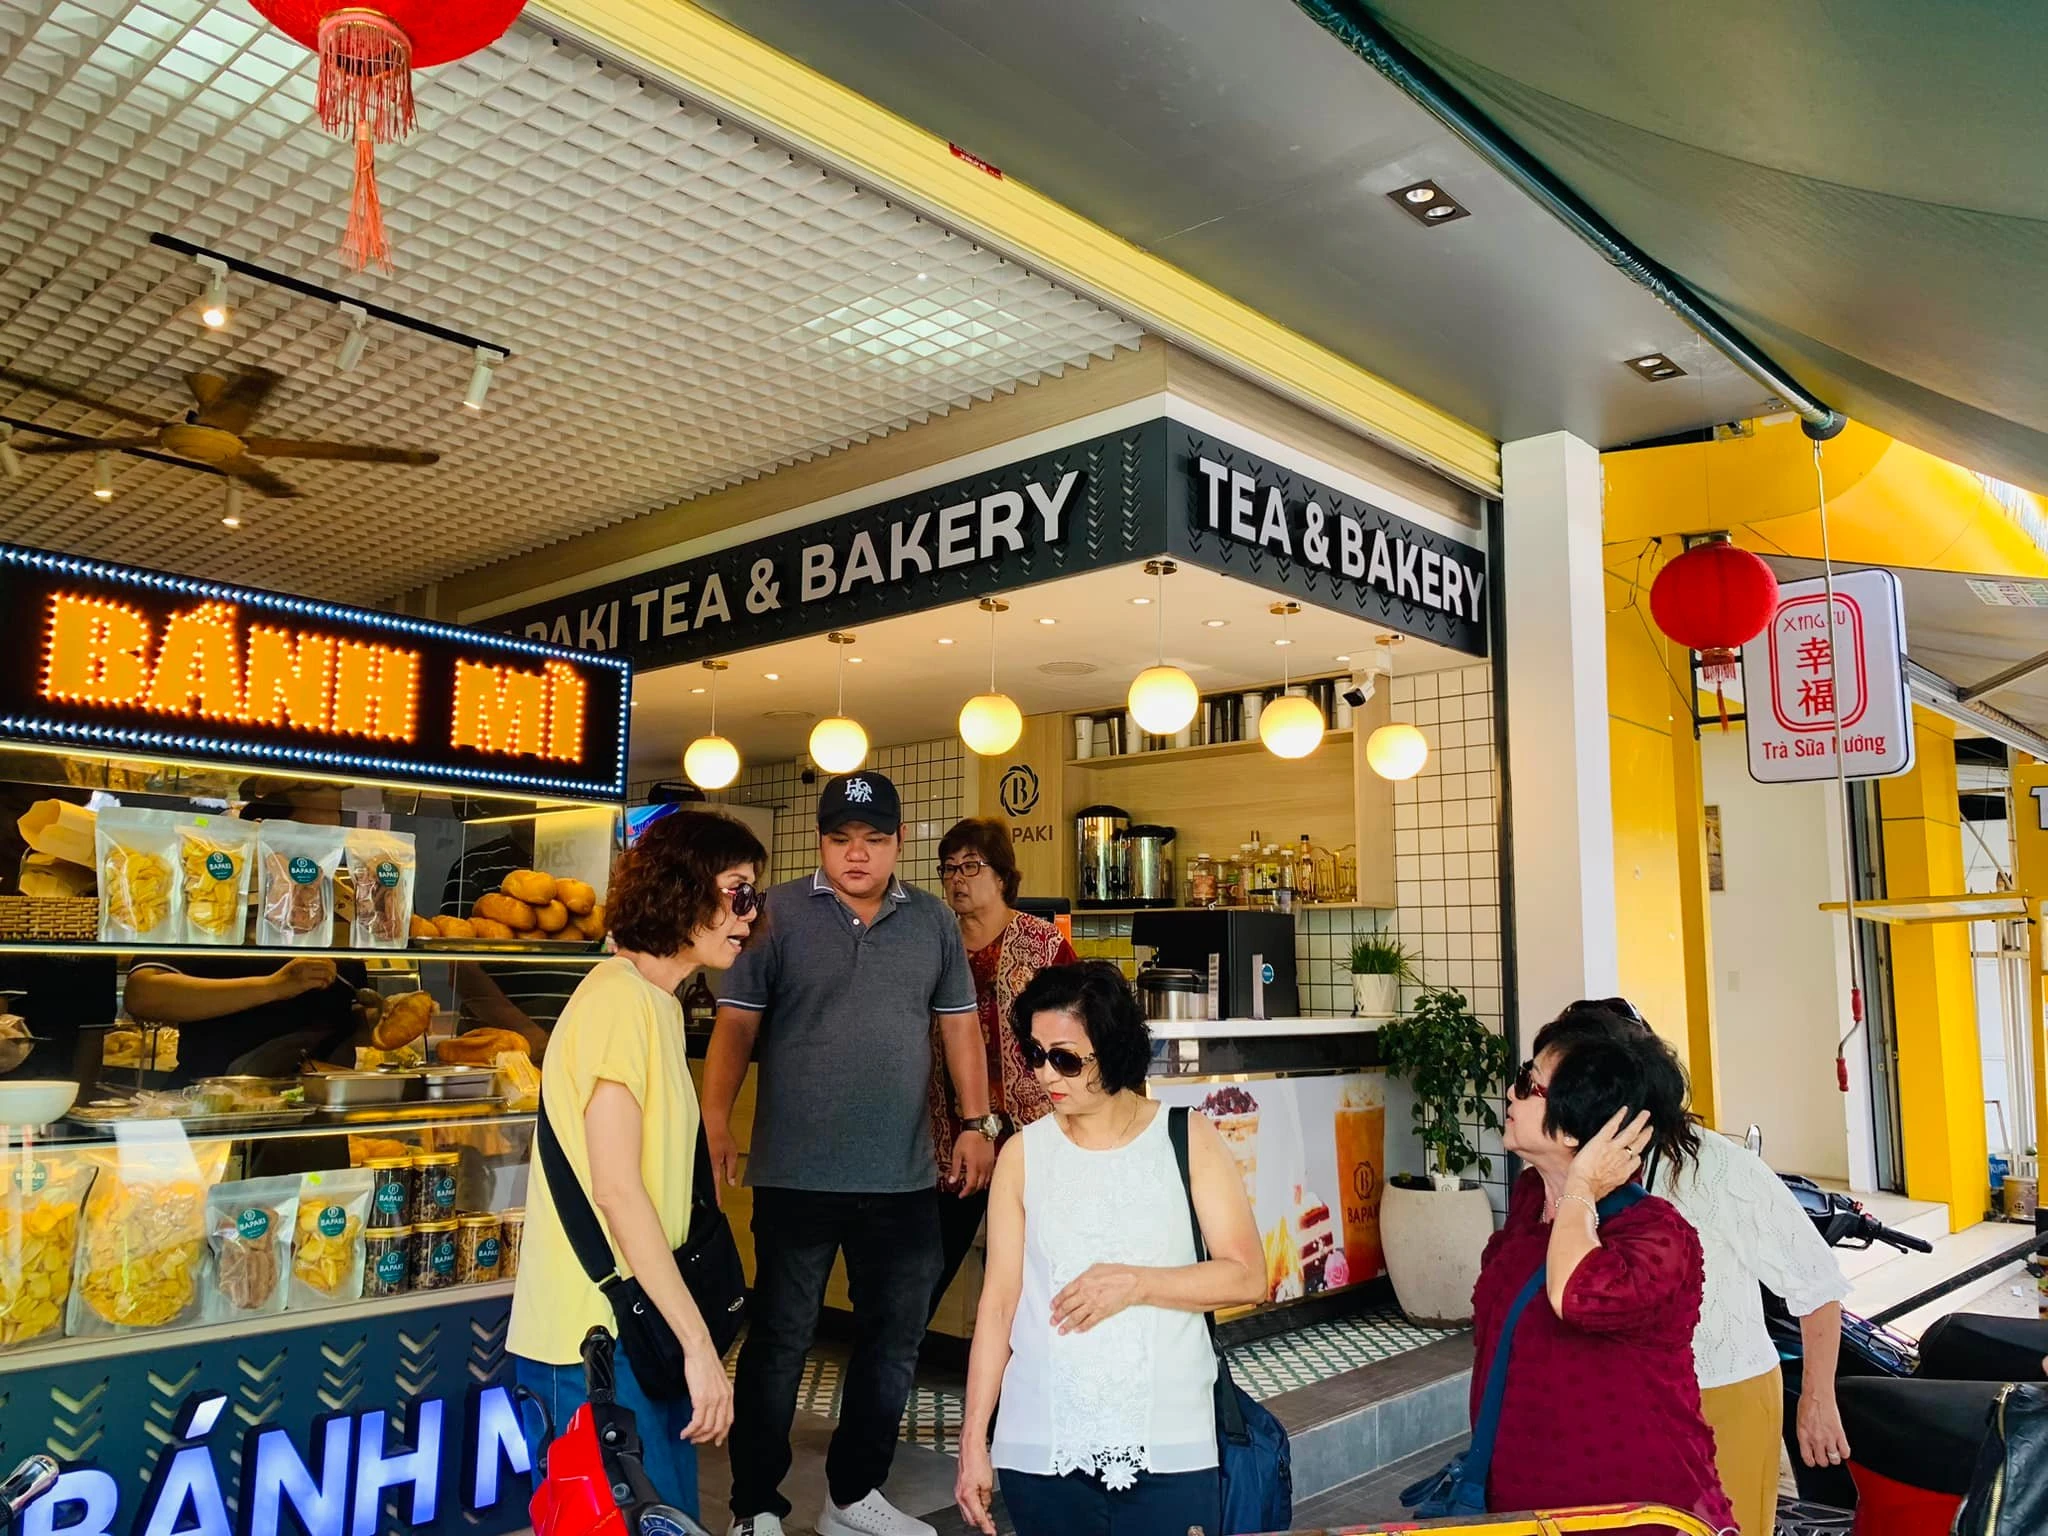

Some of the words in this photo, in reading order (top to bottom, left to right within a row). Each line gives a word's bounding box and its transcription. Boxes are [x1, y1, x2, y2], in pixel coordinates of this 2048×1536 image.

[1200, 457, 1292, 555] TEA
[1303, 501, 1331, 569] &
[1340, 515, 1484, 623] BAKERY
[632, 573, 731, 641] TEA
[745, 558, 781, 614] &
[801, 470, 1079, 602] BAKERY
[41, 594, 418, 745] BÁNH
[1796, 636, 1836, 717] 幸福
[1763, 741, 1789, 759] Trà
[1795, 737, 1825, 758] Sữa
[1012, 825, 1053, 843] PAKI
[209, 862, 232, 871] BAPAKI
[290, 866, 316, 875] BAPAKI
[239, 1217, 266, 1232] BAPAKI
[320, 1218, 345, 1227] BAPAKI
